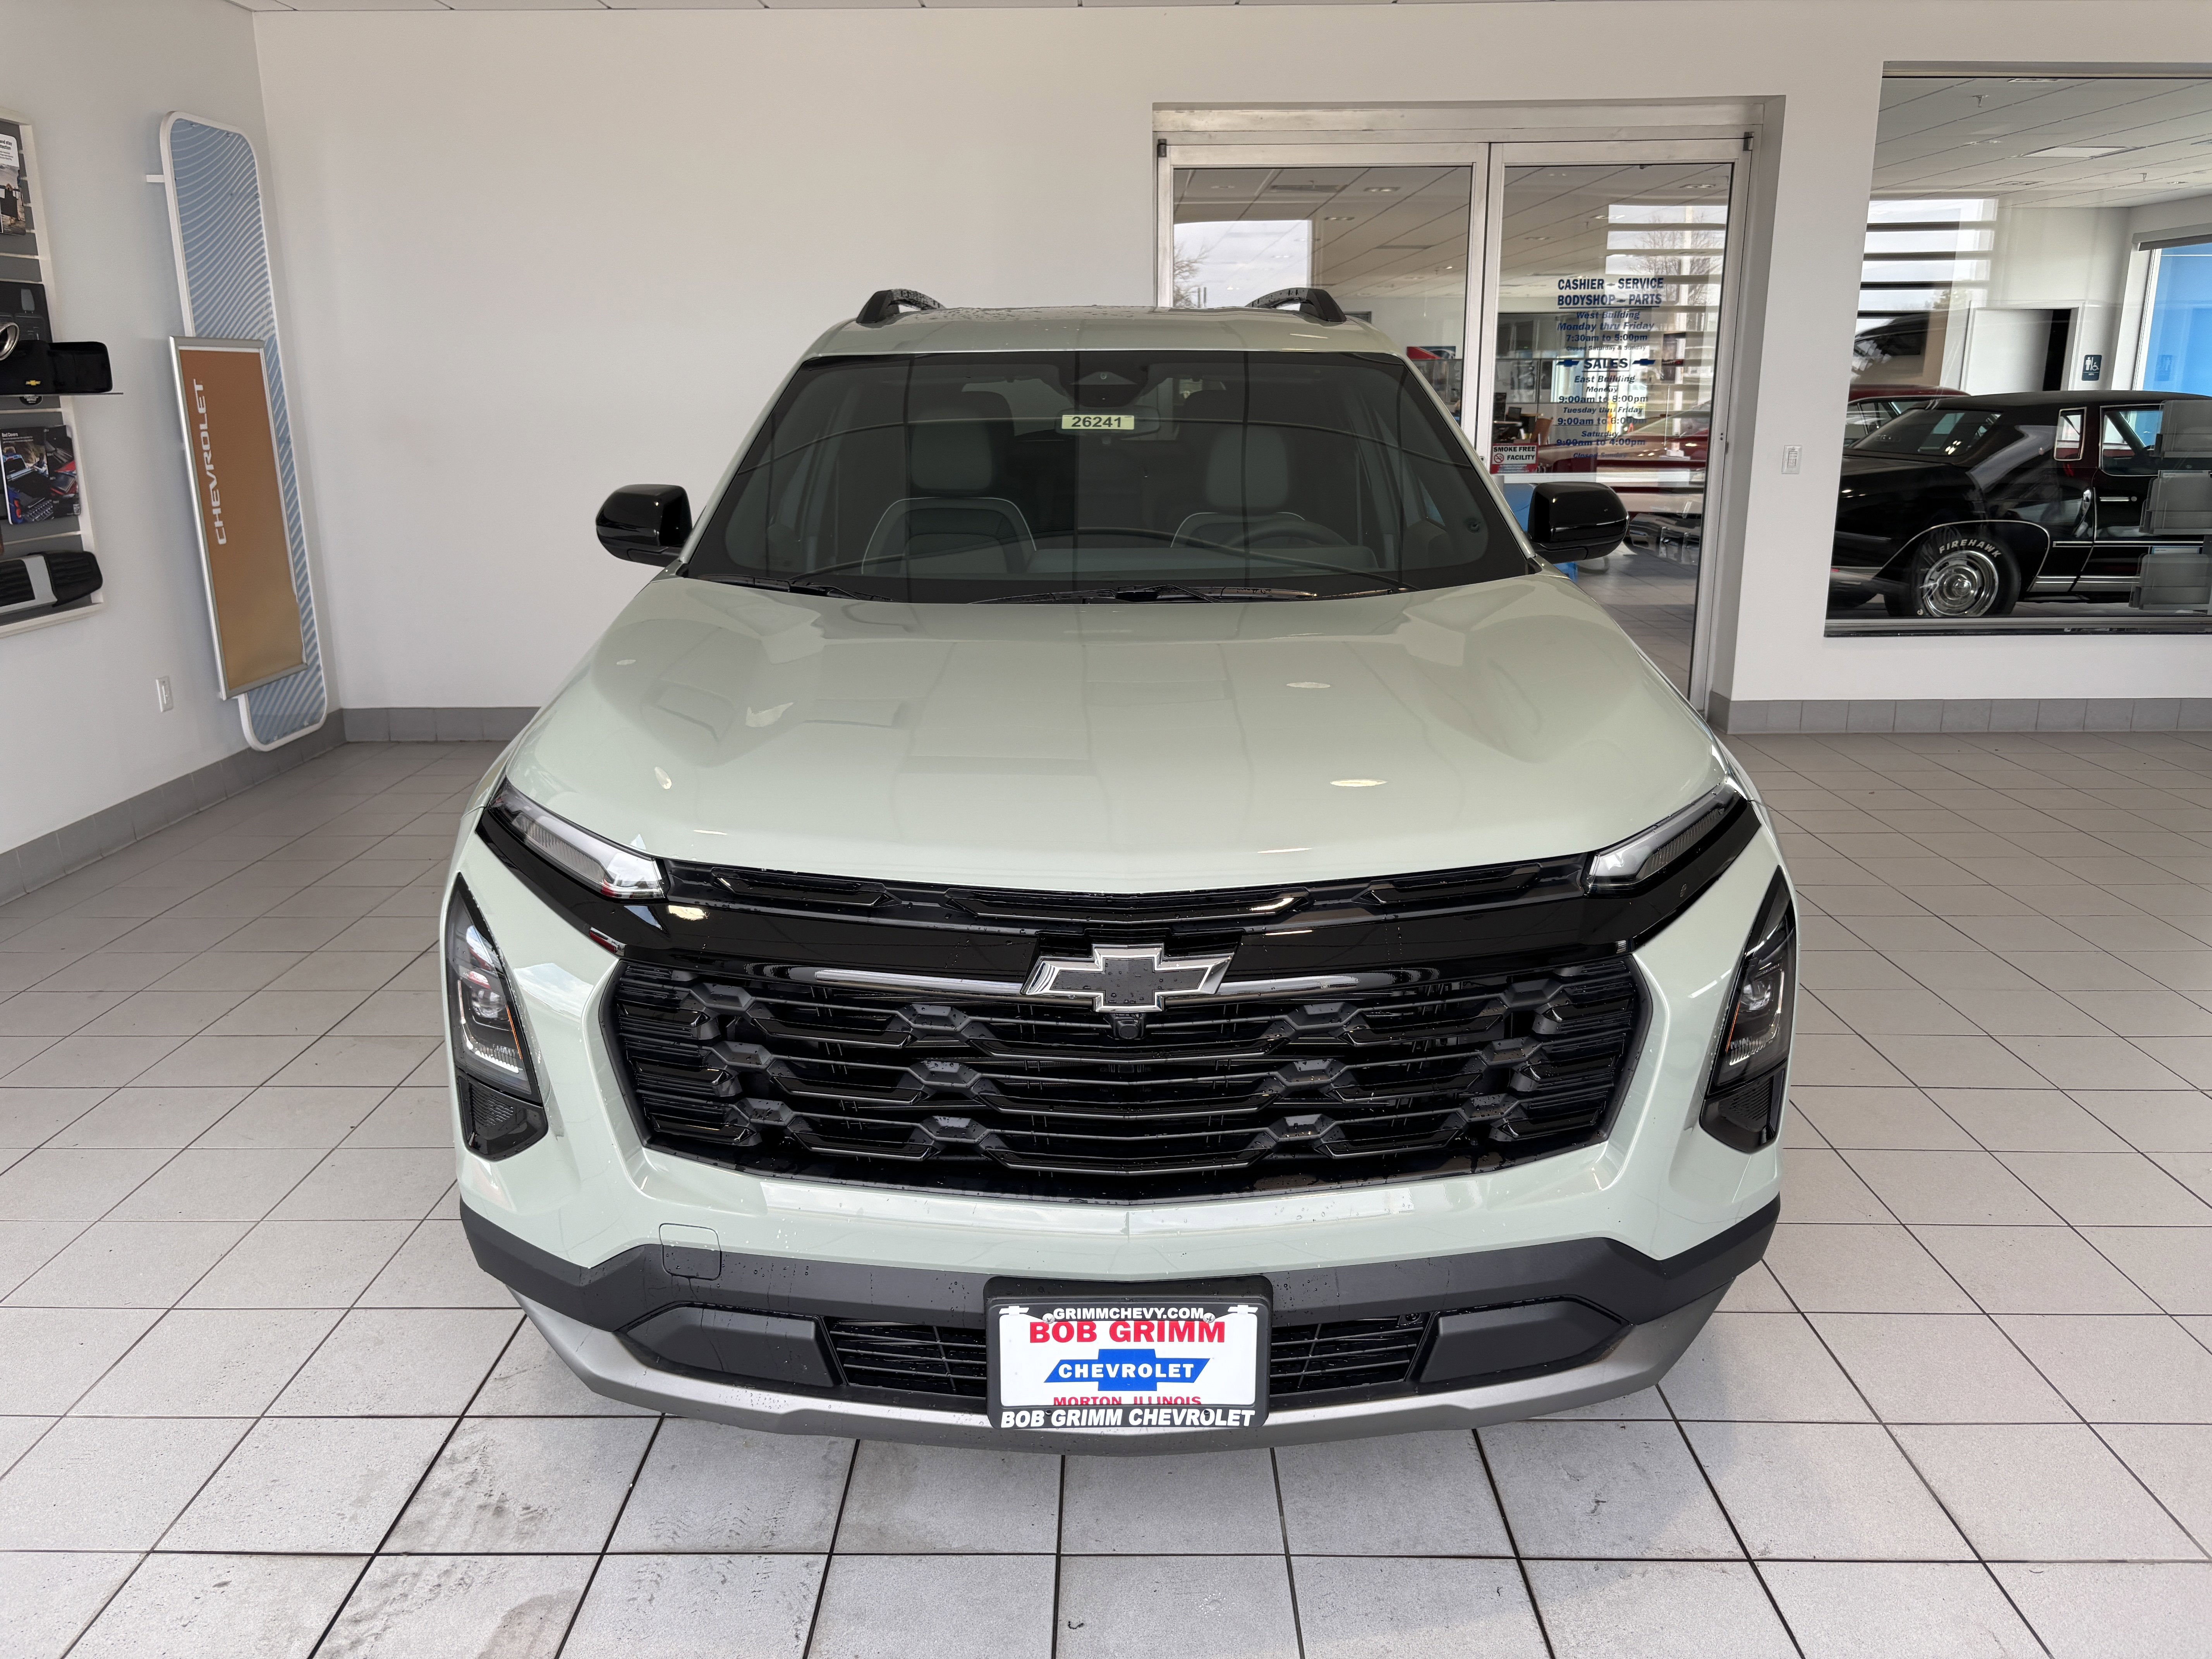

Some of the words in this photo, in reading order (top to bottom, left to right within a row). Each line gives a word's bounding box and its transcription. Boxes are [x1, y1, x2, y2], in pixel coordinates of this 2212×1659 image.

[1558, 279, 1604, 290] CASHIER
[1618, 278, 1664, 289] SERVICE
[1558, 294, 1615, 306] BODYSHOP
[1629, 294, 1662, 305] PARTS
[1602, 311, 1640, 320] Building
[1557, 323, 1596, 331] Monday
[1623, 322, 1654, 331] Friday
[1614, 334, 1647, 342] 5:00pm
[1584, 358, 1628, 369] SALES
[1597, 375, 1635, 383] Building
[1071, 416, 1121, 428] 26241
[1609, 438, 1645, 447] 4:00pm
[194, 379, 227, 544] CHEVROLET
[1939, 539, 2001, 558] FIREHAWK
[1053, 1307, 1204, 1320] GRIMMCHEVY.COM
[1030, 1321, 1097, 1343] BOB
[1109, 1321, 1224, 1342] GRIMM
[1058, 1363, 1194, 1378] CHEVROLET
[1054, 1396, 1121, 1406] MORTON
[1001, 1410, 1045, 1428] BOB
[1051, 1408, 1123, 1427] GRIMM
[1128, 1408, 1255, 1426] CHEVROLET
